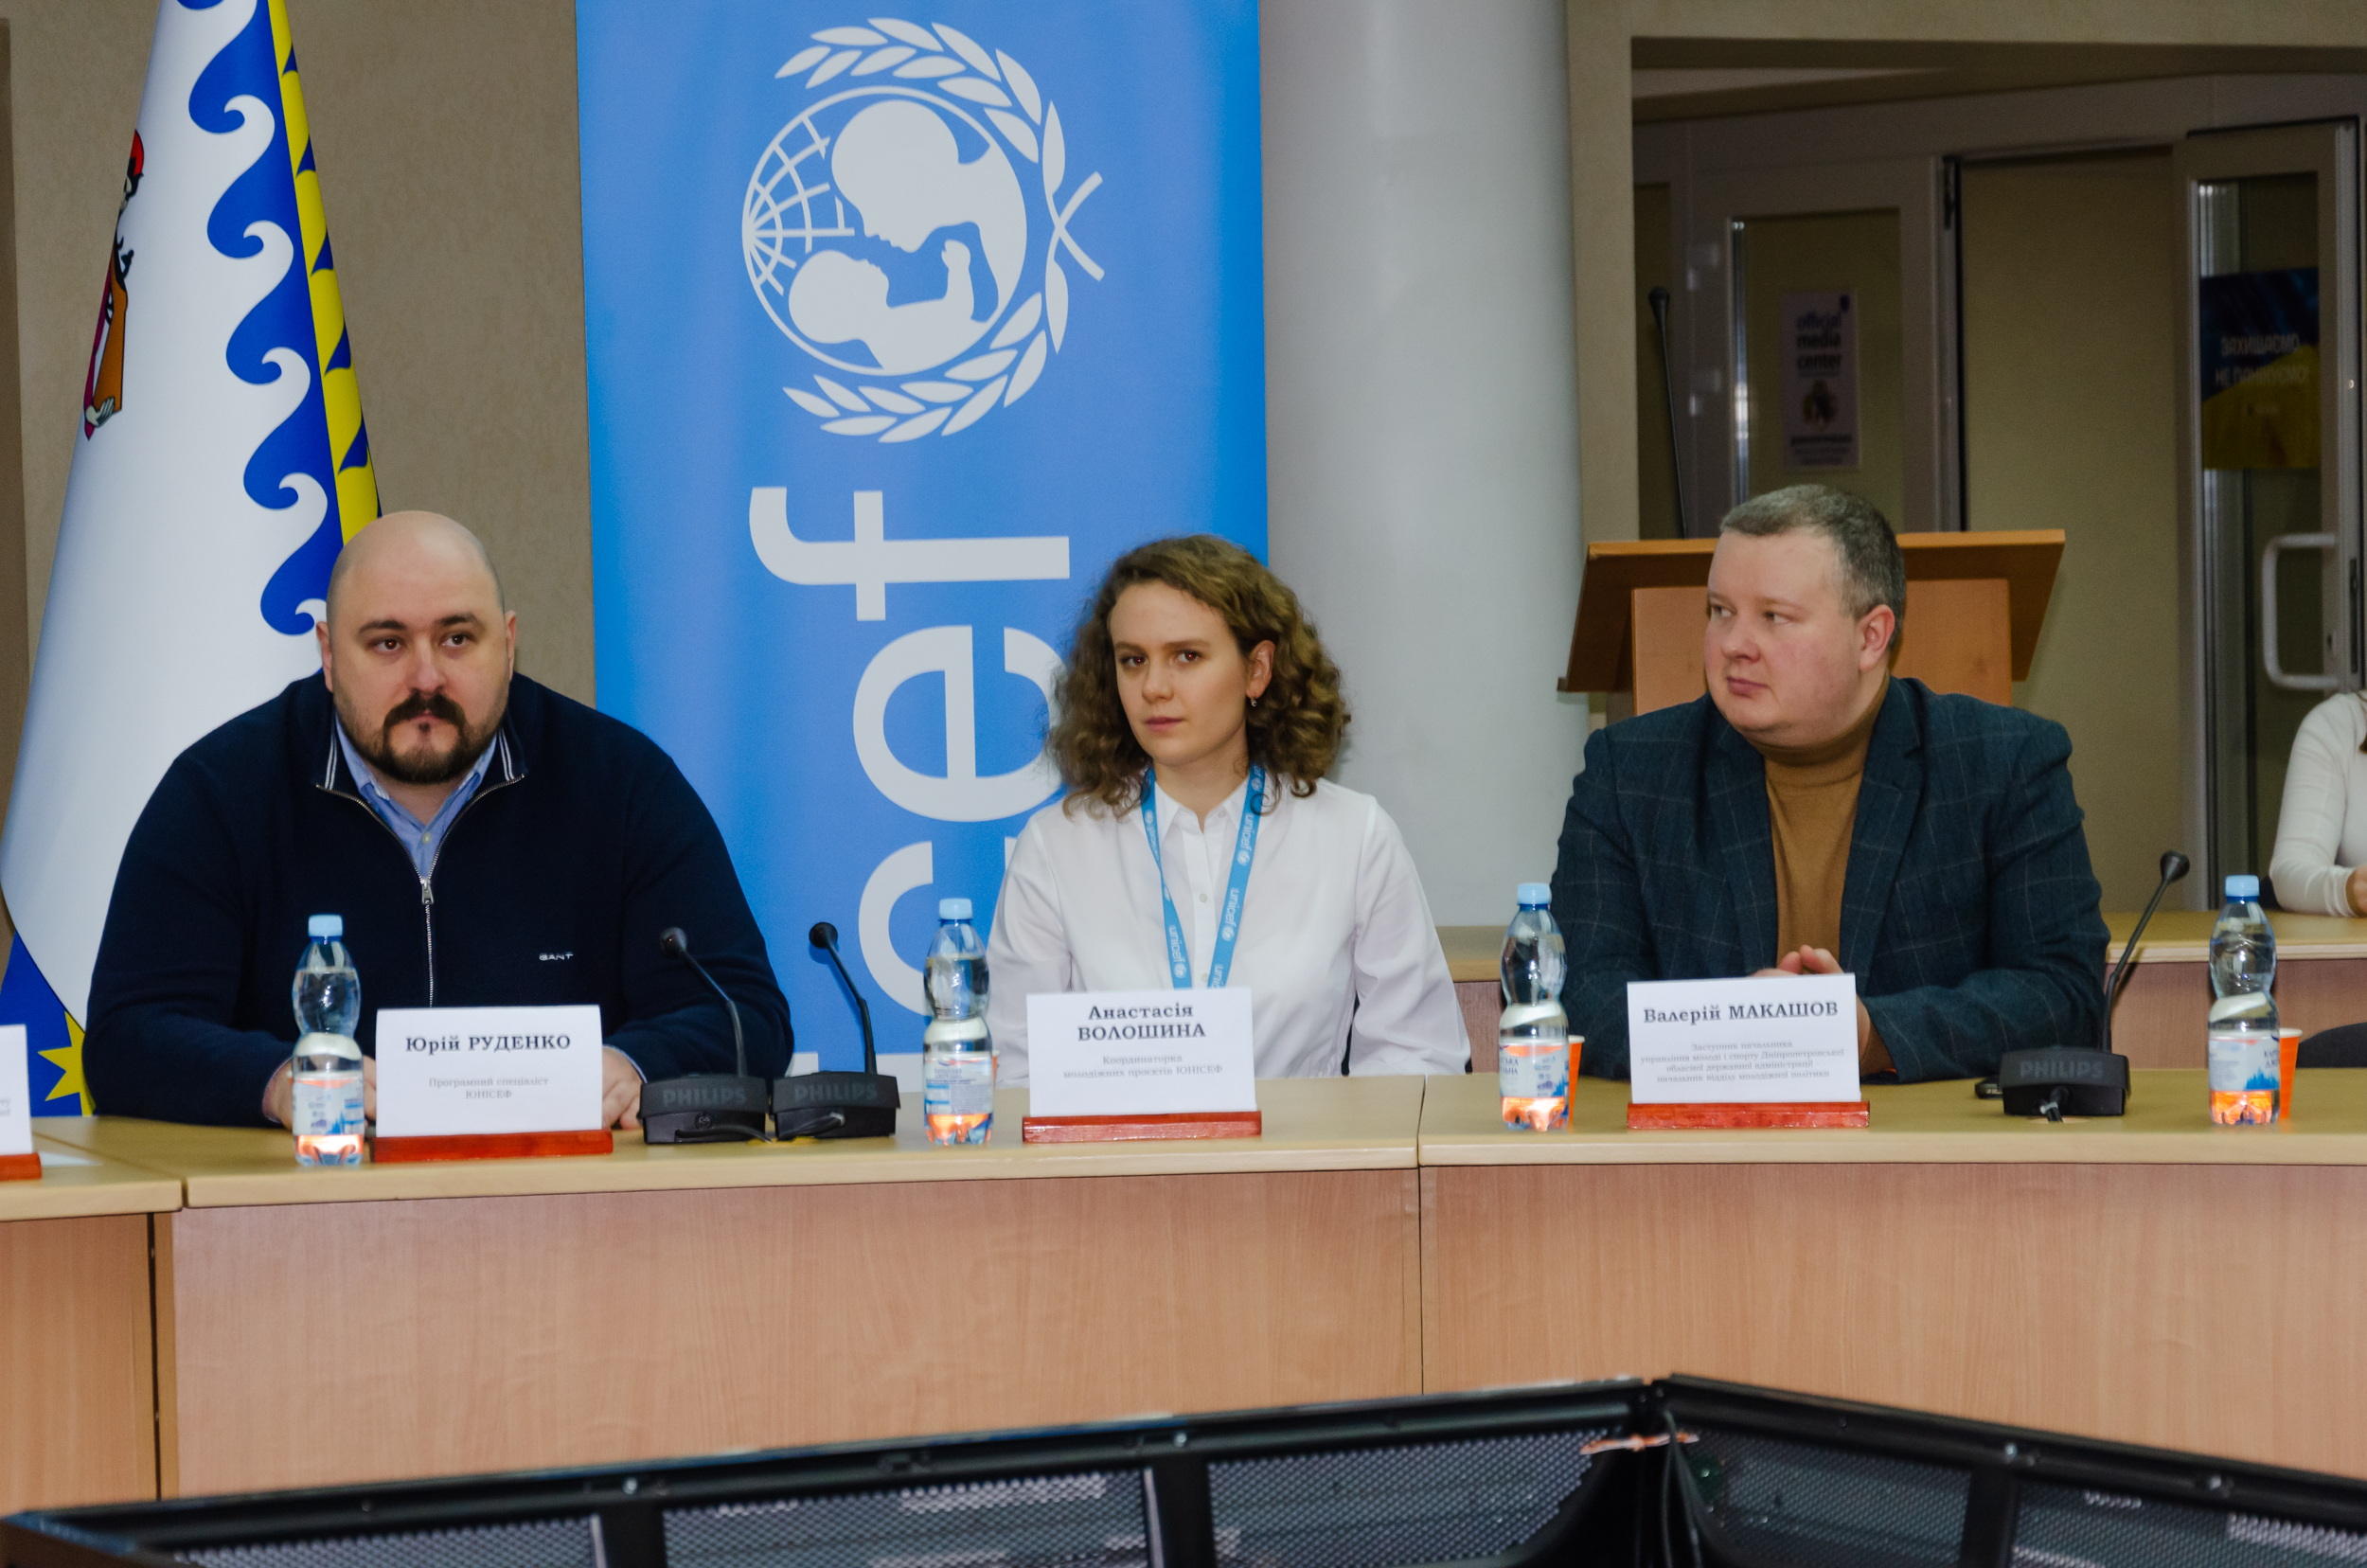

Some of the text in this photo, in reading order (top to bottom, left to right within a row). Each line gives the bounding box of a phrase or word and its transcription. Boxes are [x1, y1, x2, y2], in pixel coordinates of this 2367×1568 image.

[1797, 328, 1842, 348] media
[1797, 353, 1842, 369] center
[1240, 813, 1255, 852] unicef
[1225, 887, 1239, 926] unicef
[1168, 924, 1185, 963] unicef
[539, 953, 574, 961] GANT
[1089, 1002, 1193, 1020] Анастасія
[1644, 1002, 1838, 1025] Валерій МАКАШОВ
[1078, 1024, 1206, 1042] ВОЛОШИНА
[406, 1034, 571, 1056] Юрій РУДЕНКО
[1691, 1042, 1792, 1052] Заступник начальника
[1103, 1055, 1183, 1065] Координаторка
[1640, 1056, 1690, 1065] управління
[1730, 1052, 1759, 1060] спорту
[1762, 1049, 1844, 1060] Дніпропетровської
[1062, 1065, 1222, 1079] молодіжних проєктів ЮНІСЕФ
[1706, 1062, 1753, 1073] державної
[1755, 1060, 1813, 1071] адміністрації
[2020, 1060, 2104, 1078] PHILIPS
[429, 1077, 548, 1088] Програмний спеціаліст
[1707, 1074, 1735, 1082] відділу
[1739, 1072, 1788, 1080] молодіжної
[1791, 1070, 1829, 1078] політики
[466, 1091, 512, 1099] ЮНІСЕФ
[664, 1088, 747, 1106] PHILIPS
[794, 1083, 878, 1102] PHILIPS
